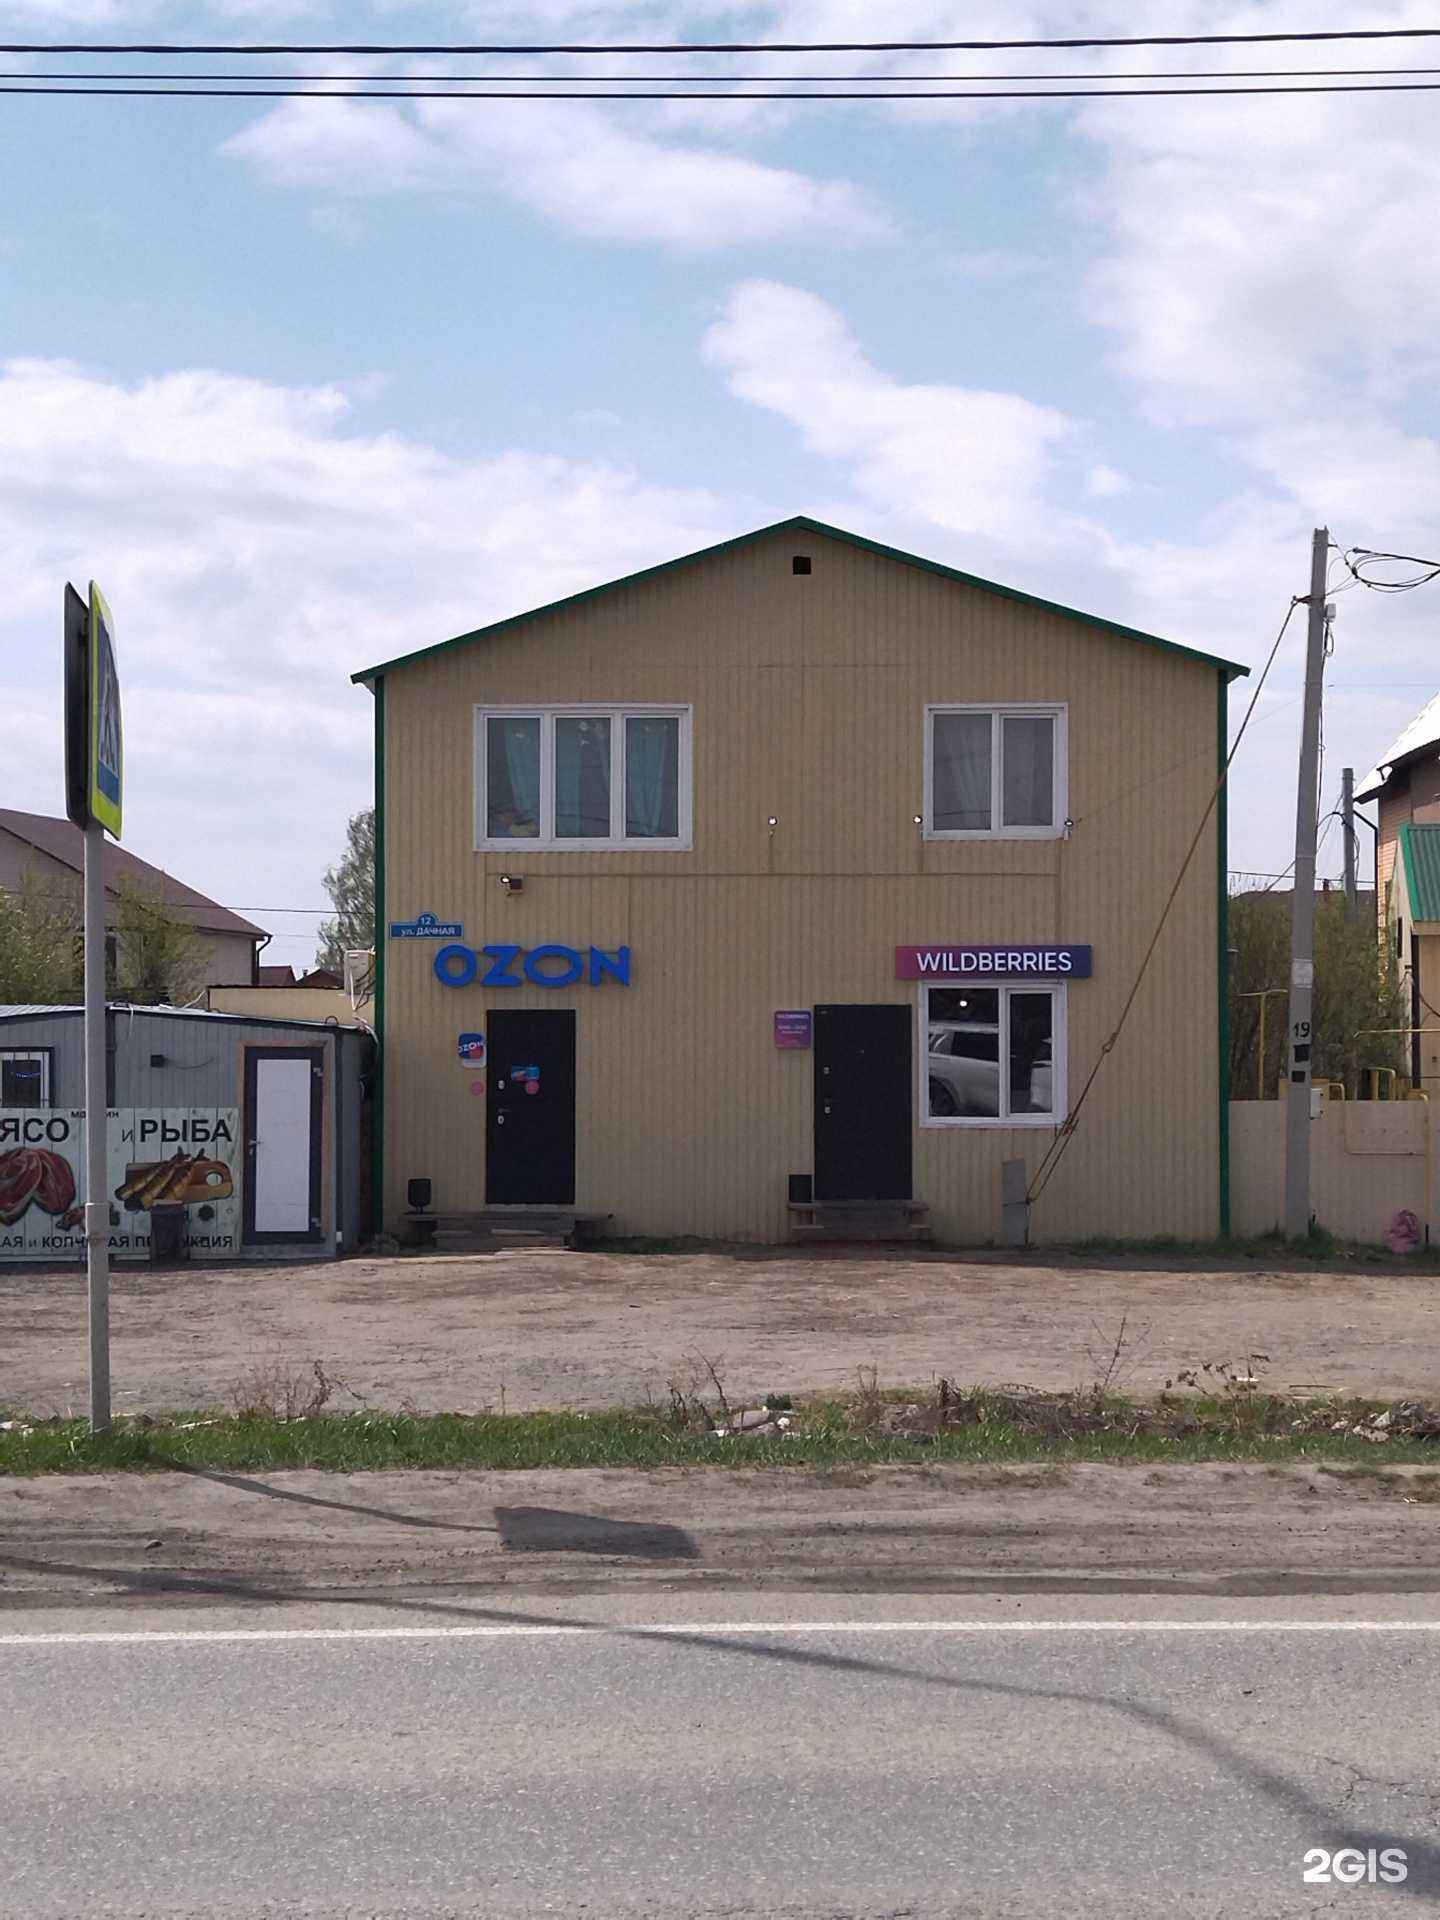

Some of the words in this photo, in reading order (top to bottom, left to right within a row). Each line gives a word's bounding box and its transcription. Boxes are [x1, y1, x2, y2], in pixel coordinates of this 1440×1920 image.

[421, 916, 431, 926] 12
[401, 928, 415, 937] ул.
[416, 927, 455, 937] ДАЧНАЯ
[434, 944, 630, 988] OZON
[916, 952, 1072, 971] WILDBERRIES
[1293, 1021, 1310, 1038] 19
[140, 1119, 232, 1142] РЫБА
[42, 1236, 130, 1248] КОПЧАЯ
